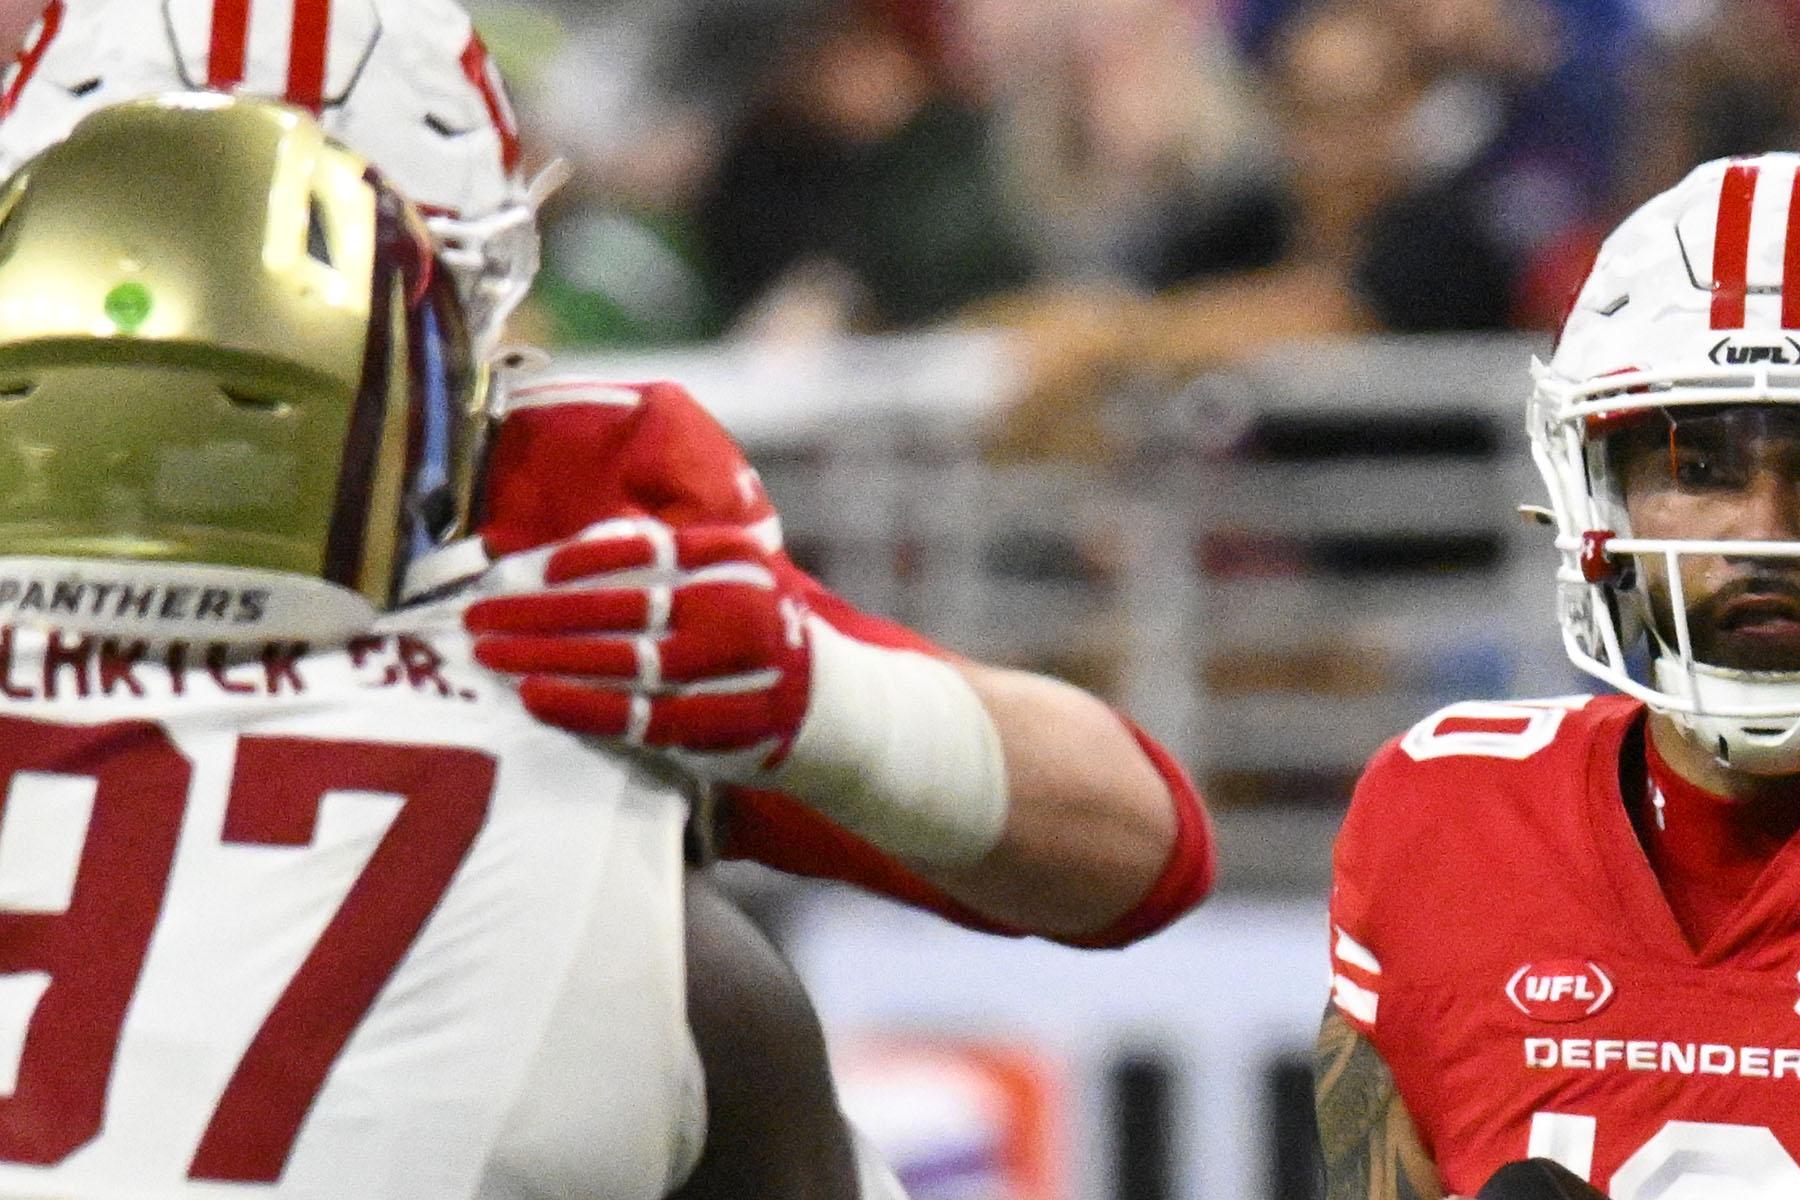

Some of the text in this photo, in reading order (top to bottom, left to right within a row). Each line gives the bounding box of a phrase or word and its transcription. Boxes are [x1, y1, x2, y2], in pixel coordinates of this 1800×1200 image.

[0, 579, 271, 622] PANTHERS
[0, 713, 500, 1187] 97
[1525, 975, 1596, 1002] UFL
